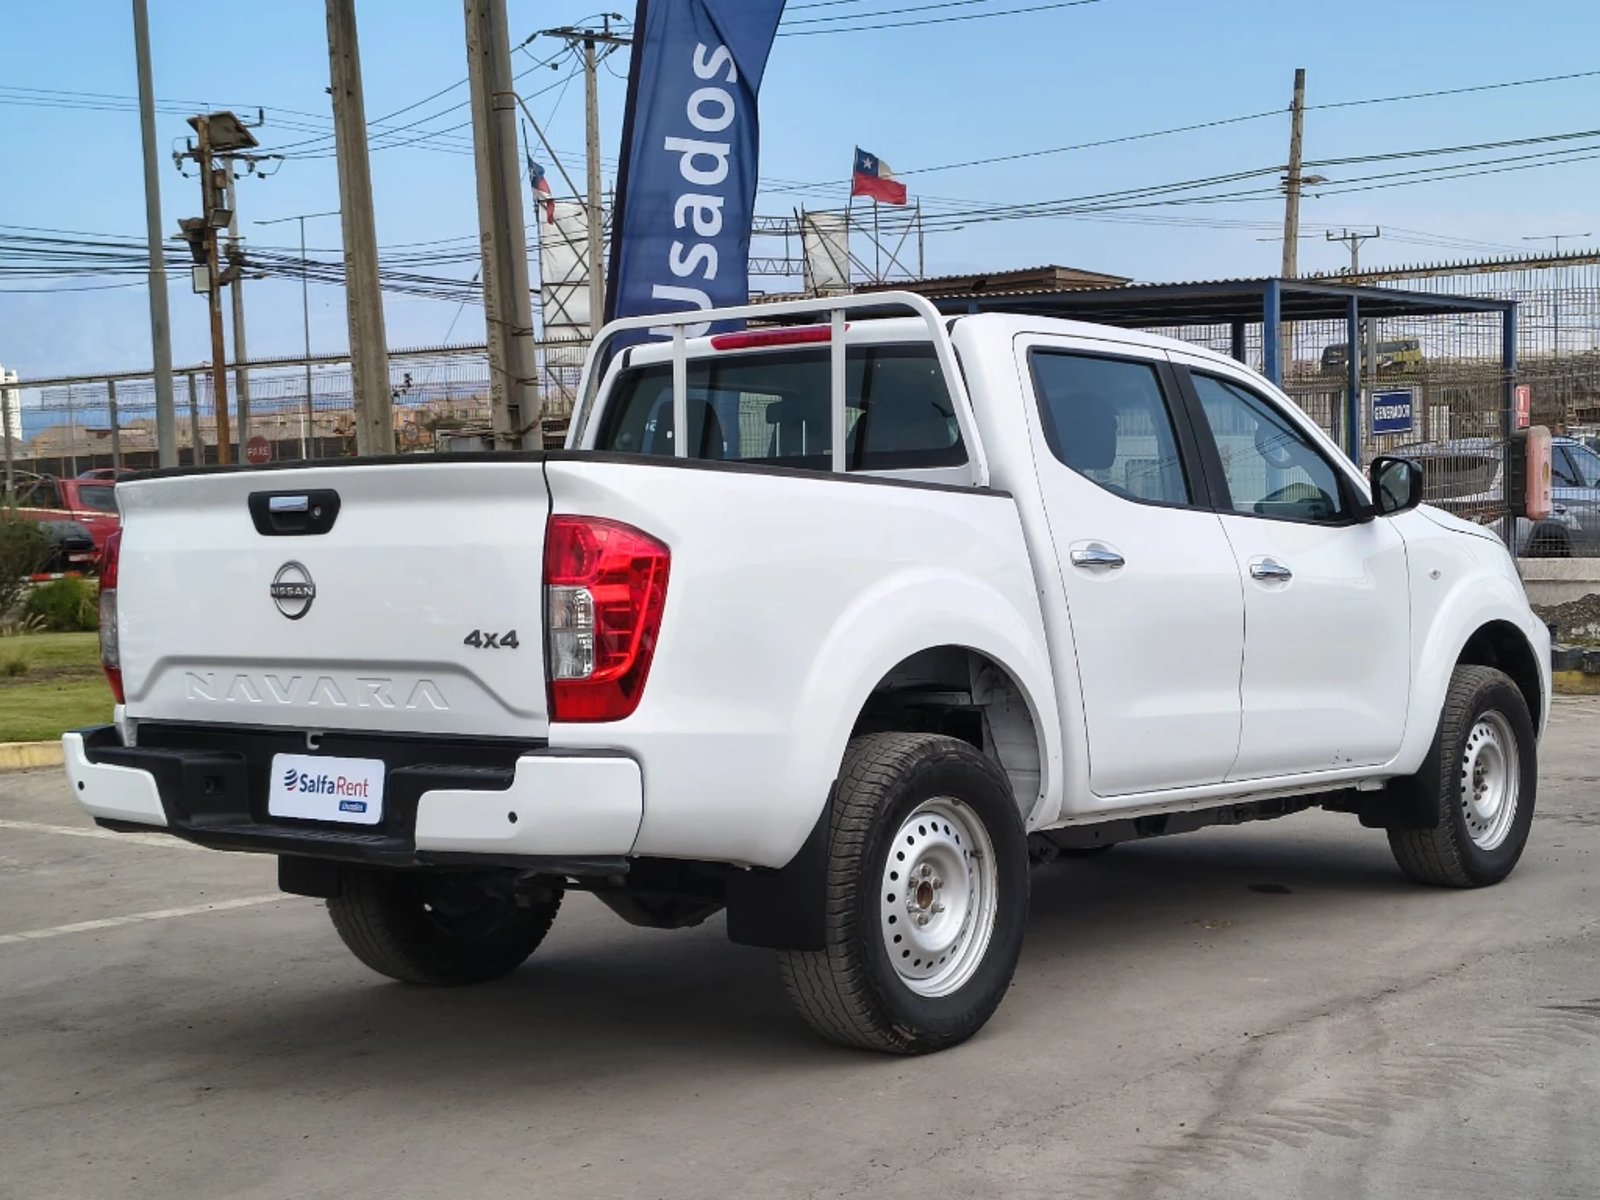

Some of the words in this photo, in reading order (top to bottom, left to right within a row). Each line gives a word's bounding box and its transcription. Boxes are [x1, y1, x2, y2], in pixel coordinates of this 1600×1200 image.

[649, 42, 738, 339] Usados
[1374, 404, 1410, 420] GENERADOR
[271, 585, 314, 597] NISSAN
[184, 671, 450, 711] NAVARA
[299, 773, 369, 798] SalfaRent
